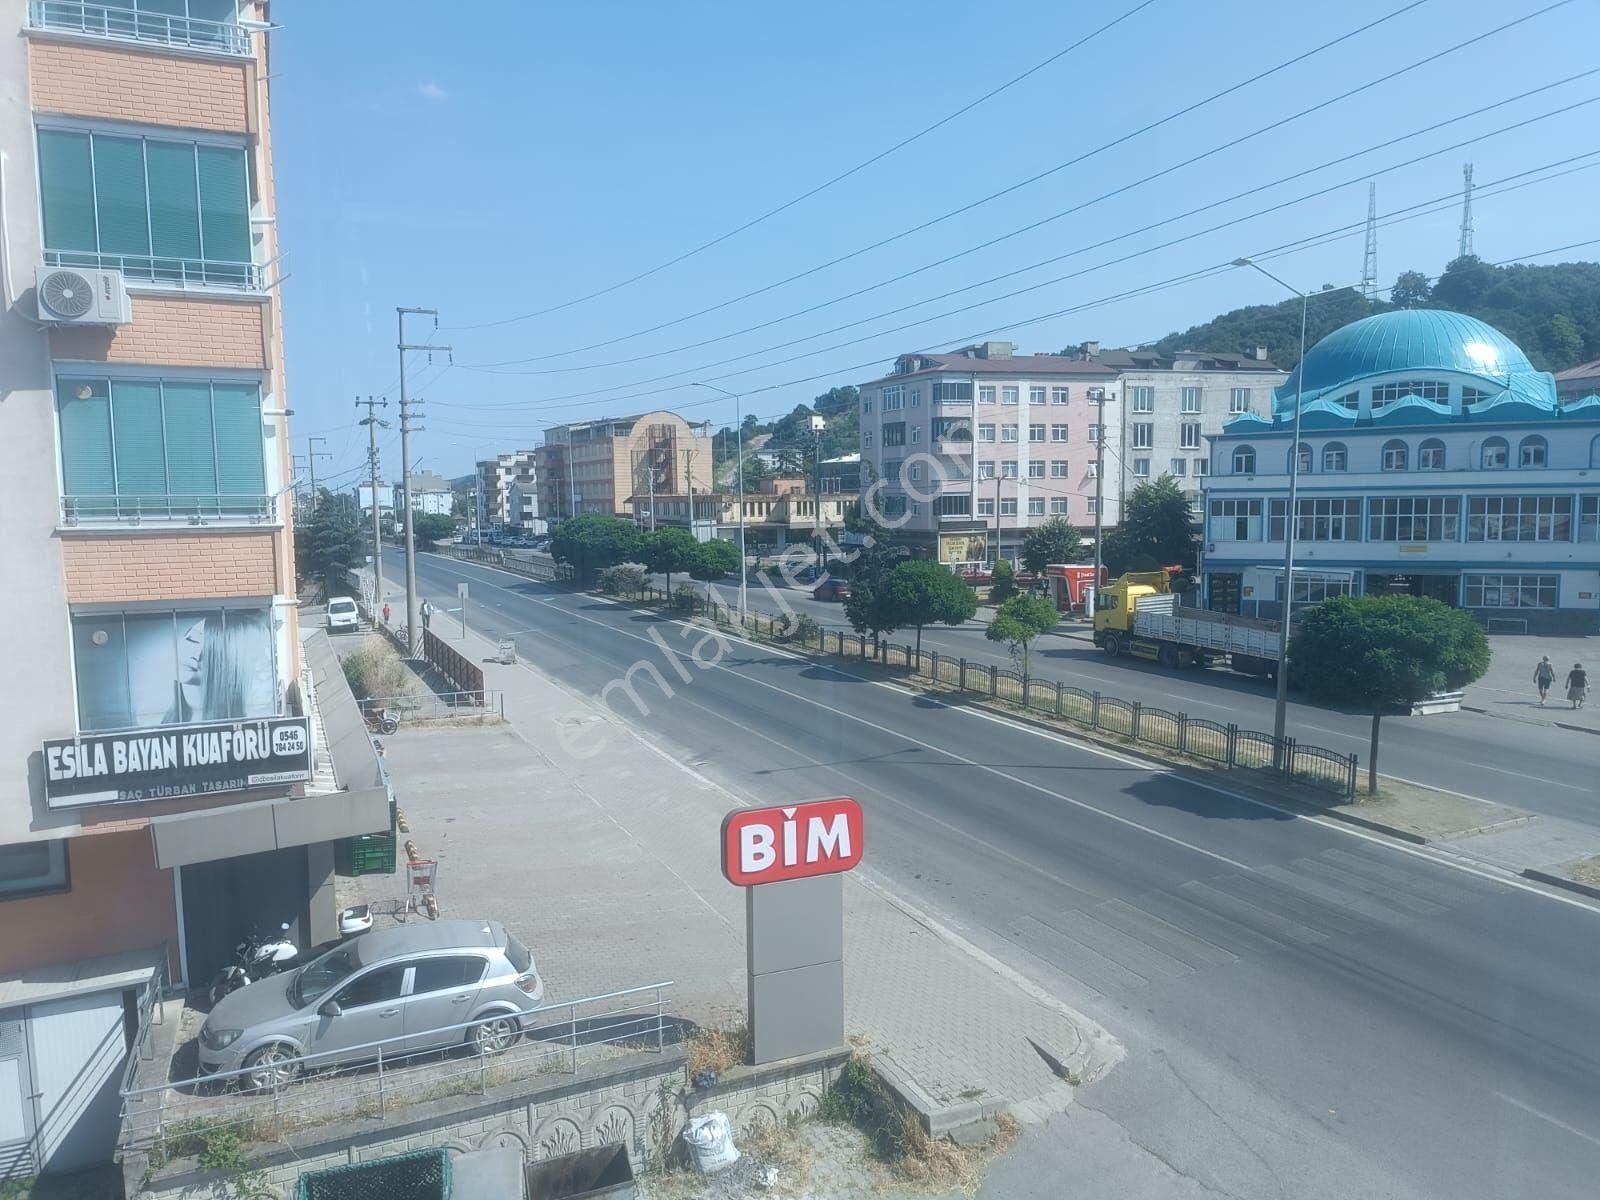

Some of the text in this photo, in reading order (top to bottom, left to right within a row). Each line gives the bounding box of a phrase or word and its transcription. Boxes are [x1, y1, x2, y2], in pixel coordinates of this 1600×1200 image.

[279, 730, 299, 741] 0546
[113, 735, 178, 774] BAYAN
[183, 721, 271, 767] KUAFÖRÜ
[287, 741, 295, 751] 24
[119, 789, 143, 801] SAÇ
[740, 807, 852, 873] BİM
